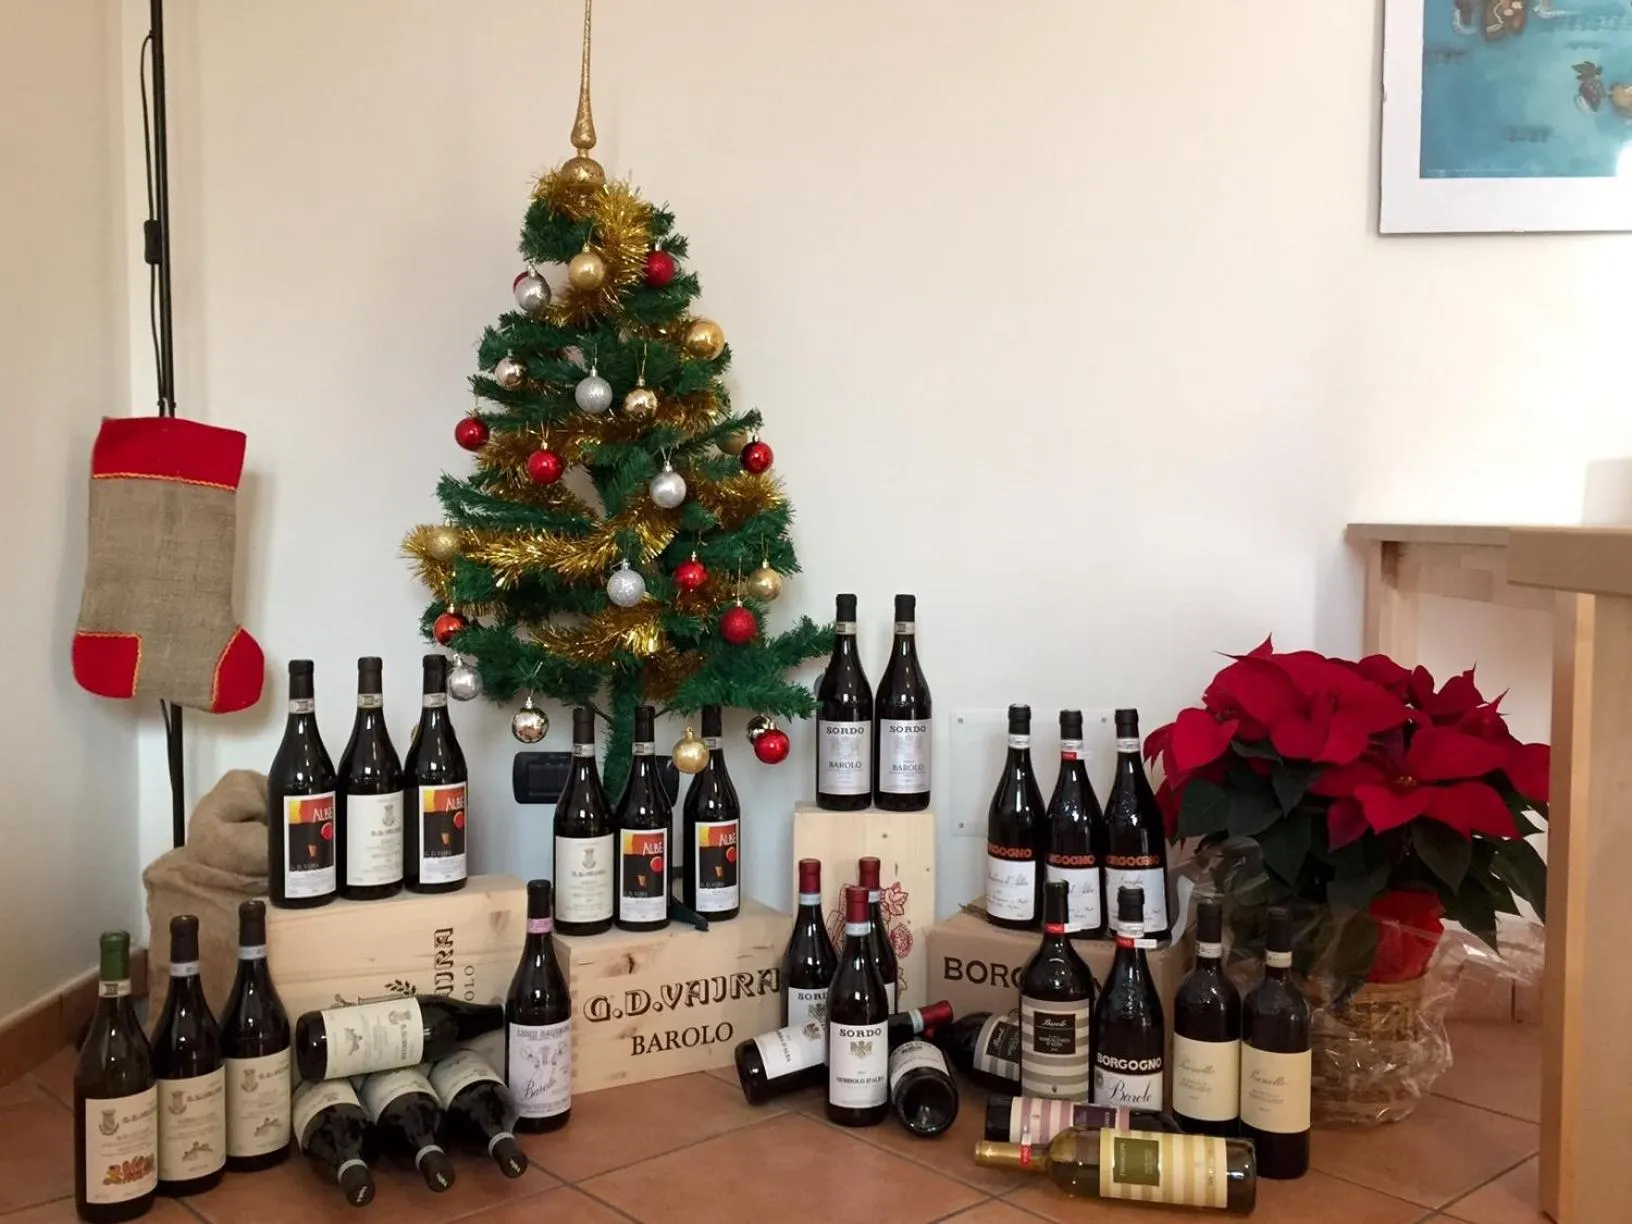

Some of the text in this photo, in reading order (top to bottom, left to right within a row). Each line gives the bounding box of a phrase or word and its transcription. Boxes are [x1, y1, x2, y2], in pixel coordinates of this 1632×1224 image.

[826, 726, 865, 736] SORDO
[889, 725, 927, 734] SORDO
[828, 760, 862, 770] BAROLO
[892, 762, 925, 772] BAROLO
[642, 841, 664, 856] ALBE
[583, 967, 780, 1022] G.D.VAJRA
[631, 1022, 734, 1056] BAROLO
[839, 1027, 882, 1038] SORDO
[1097, 1052, 1162, 1071] BORGOGNO
[1104, 1076, 1153, 1104] Barolo
